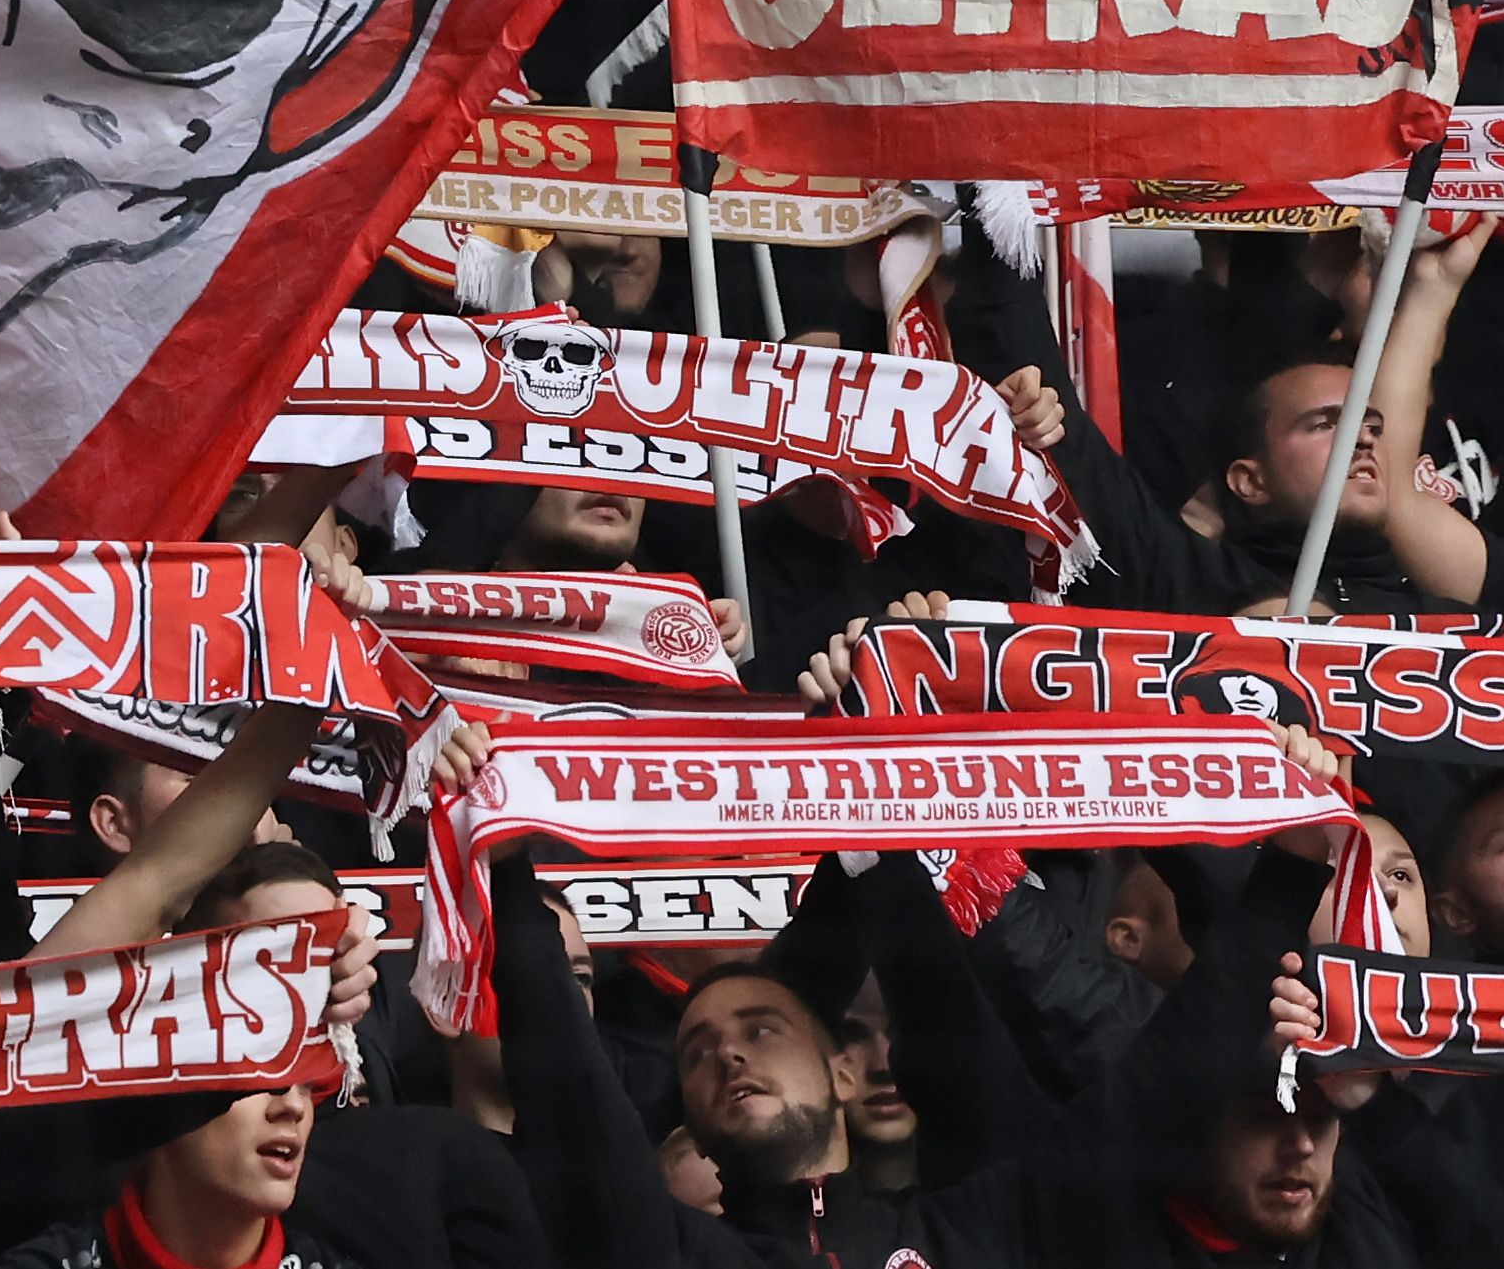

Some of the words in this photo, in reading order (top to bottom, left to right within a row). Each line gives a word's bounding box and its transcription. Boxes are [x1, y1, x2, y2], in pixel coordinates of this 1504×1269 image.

[510, 182, 804, 233] POKALSEGER
[384, 579, 613, 633] ESSEN
[535, 753, 1095, 803] WESTTRIBÜNE
[1106, 752, 1339, 800] ESSEN
[718, 803, 778, 823] IMMER
[782, 798, 843, 823] ÄRGER
[847, 802, 877, 822] MIT
[881, 801, 917, 822] DEN
[921, 801, 979, 822] JUNGS
[984, 800, 1020, 821] AUS
[1024, 799, 1060, 820] DER
[1064, 798, 1169, 820] WESTKURVE
